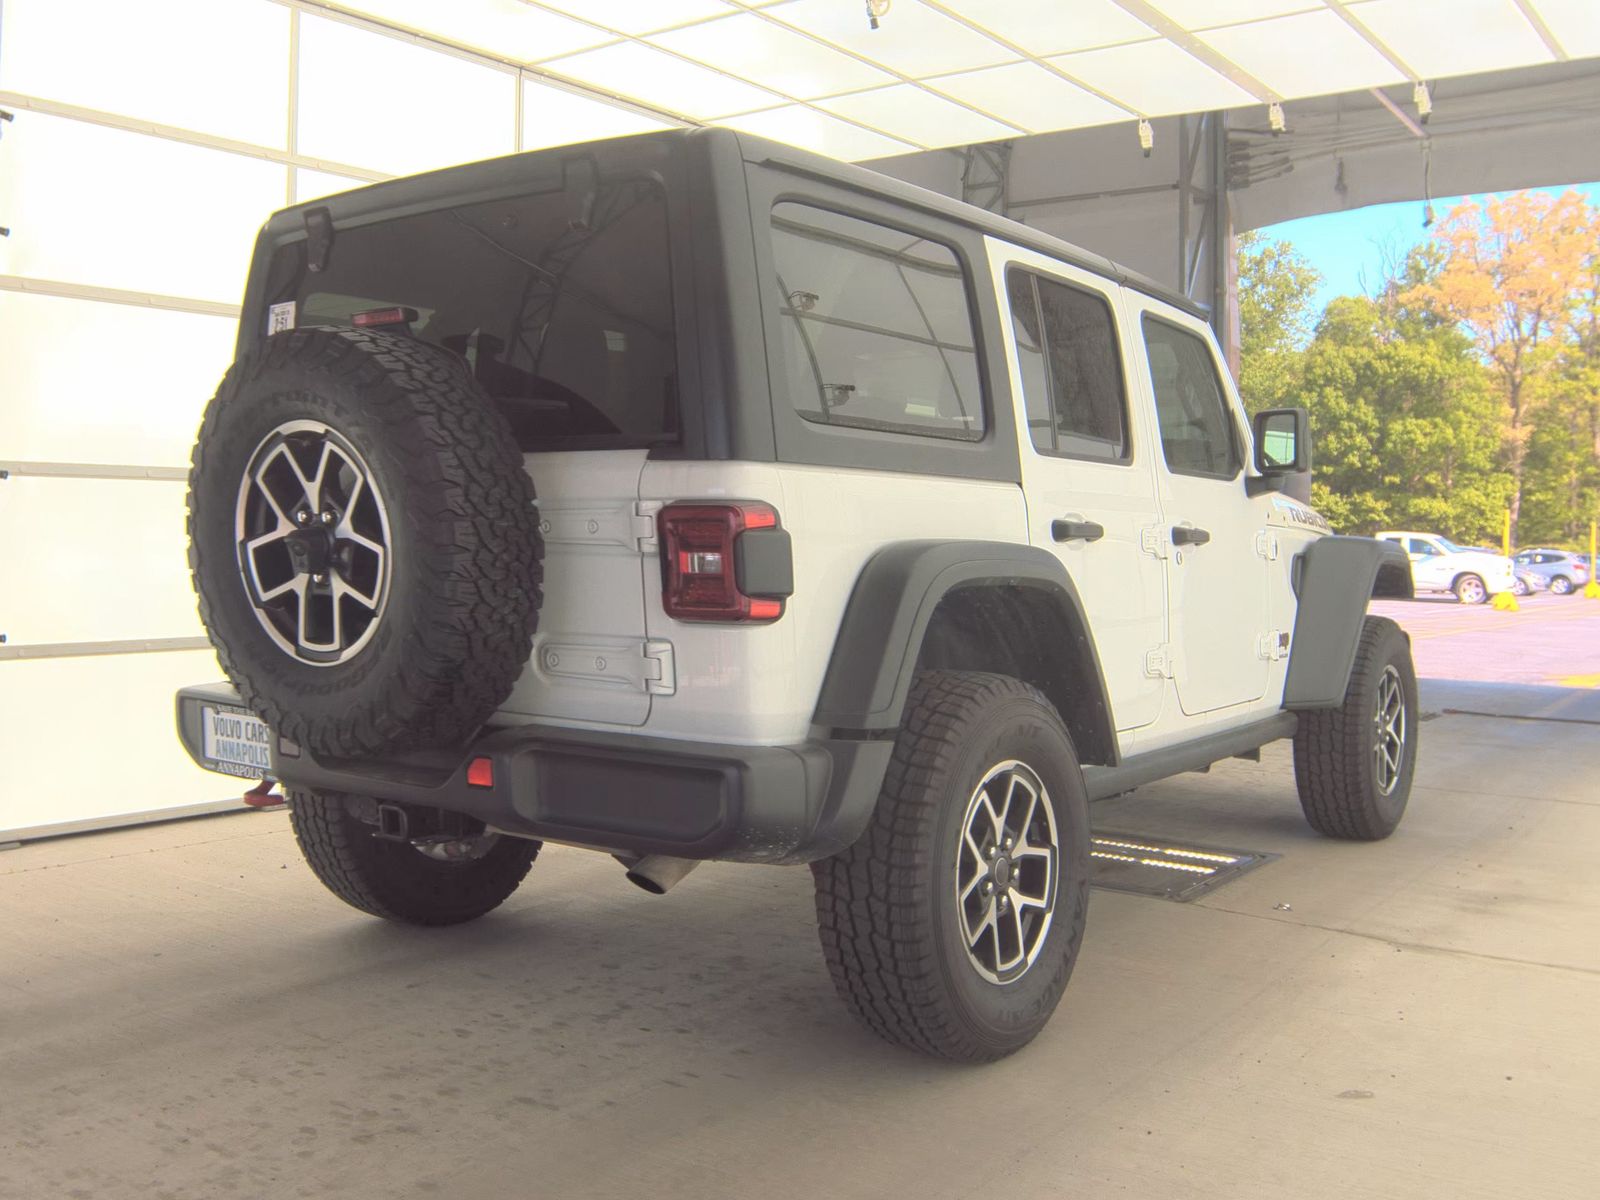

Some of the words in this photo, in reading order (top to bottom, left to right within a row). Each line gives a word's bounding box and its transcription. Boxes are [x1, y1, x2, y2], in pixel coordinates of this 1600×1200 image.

[212, 715, 241, 739] VOLVO
[245, 721, 269, 743] CARS
[215, 738, 269, 767] ANNAPOLIS
